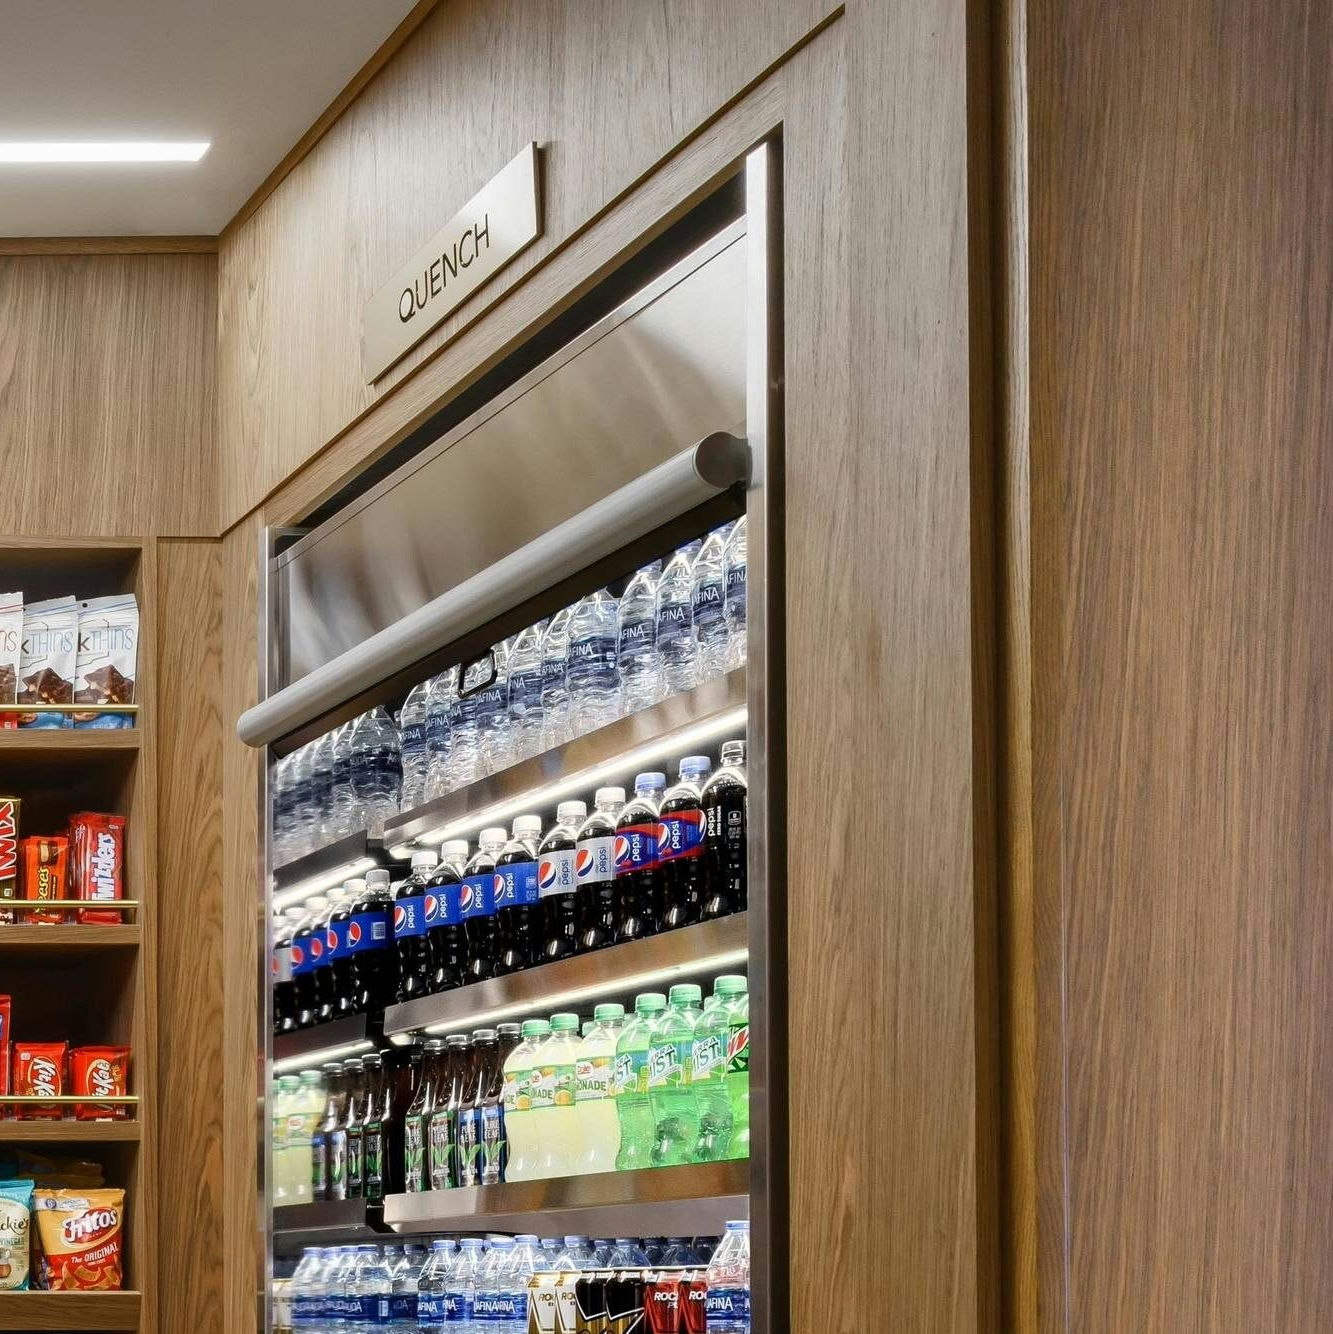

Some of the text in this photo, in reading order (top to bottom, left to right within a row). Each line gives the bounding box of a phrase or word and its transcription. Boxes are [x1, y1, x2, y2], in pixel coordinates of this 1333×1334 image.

[399, 213, 490, 323] QUENCH
[671, 820, 680, 849] pepsi
[707, 807, 716, 836] pepsi
[599, 846, 607, 874] pepsi
[632, 833, 640, 862] pepsi
[506, 872, 514, 898] pepsi
[562, 859, 570, 885] pepsi
[32, 1058, 56, 1097] KitKa
[63, 1208, 118, 1242] Fritos
[0, 1238, 25, 1246] VINEGAR
